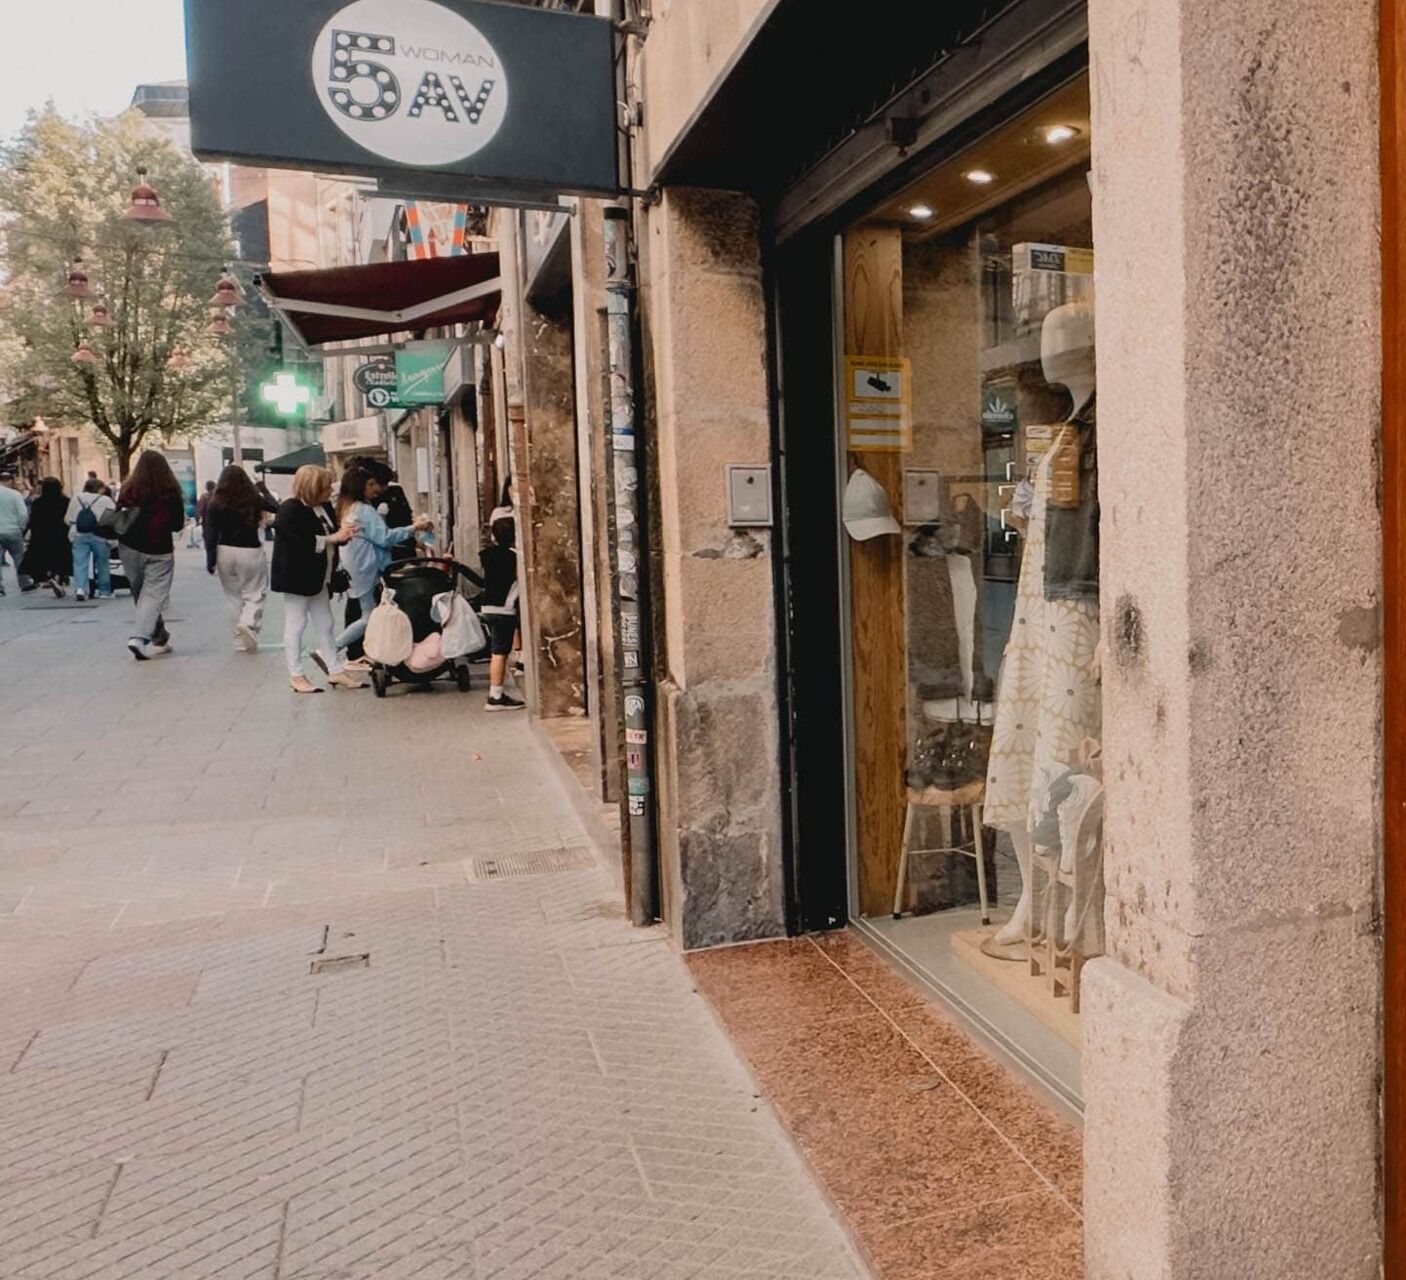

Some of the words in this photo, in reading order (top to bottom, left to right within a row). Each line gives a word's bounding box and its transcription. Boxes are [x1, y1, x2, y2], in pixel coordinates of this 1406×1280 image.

[328, 29, 401, 122] 5
[407, 72, 495, 124] AV
[400, 45, 495, 68] WOMAN
